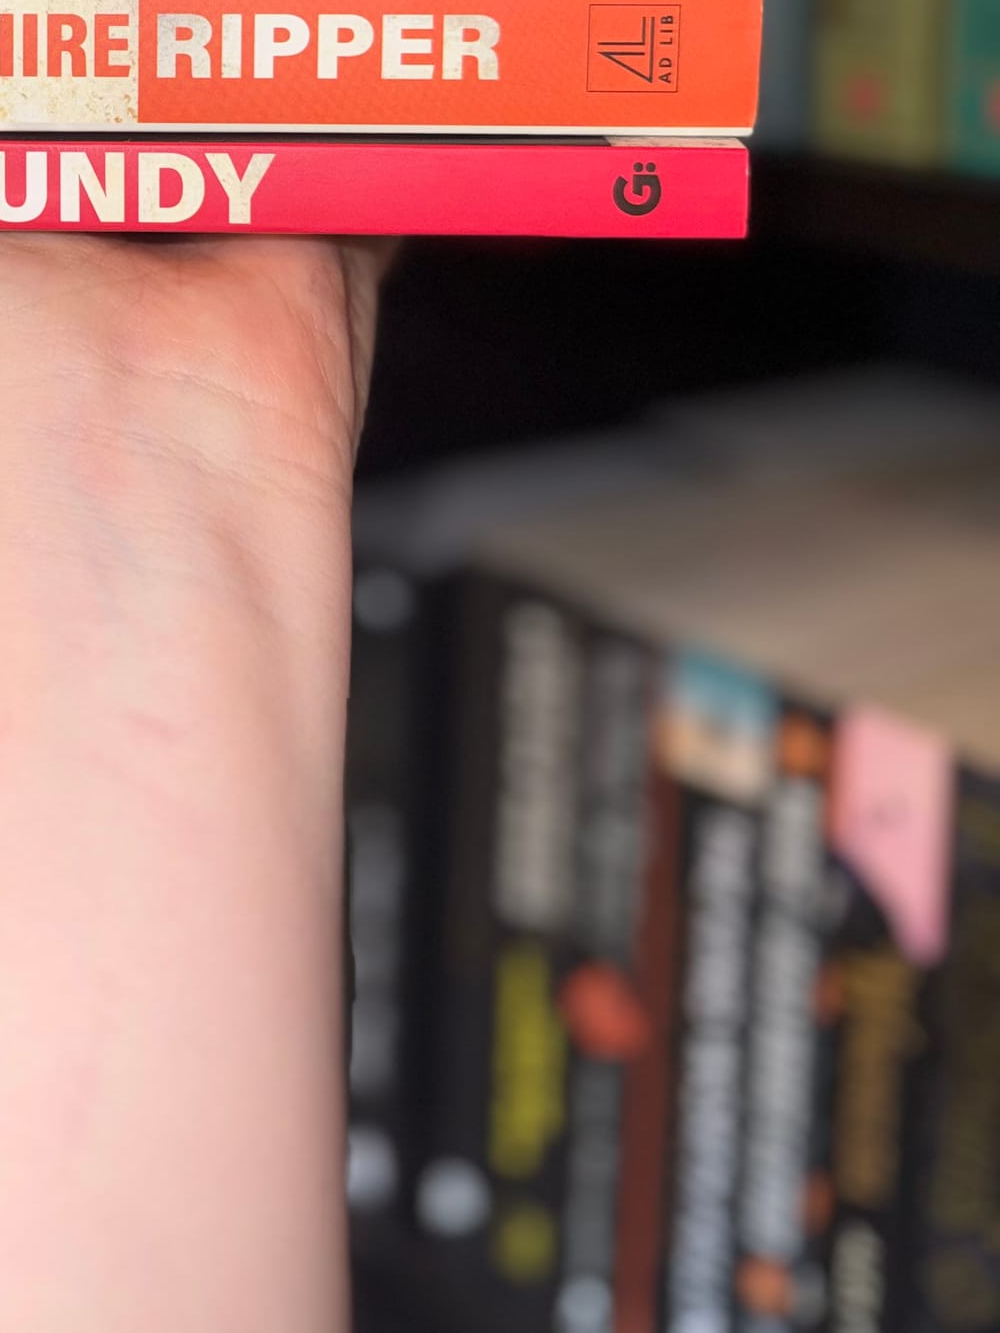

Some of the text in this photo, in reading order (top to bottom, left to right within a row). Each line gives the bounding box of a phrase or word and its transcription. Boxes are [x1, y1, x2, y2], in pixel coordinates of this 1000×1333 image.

[157, 13, 500, 80] RIPPER
[658, 15, 674, 84] AD LIB
